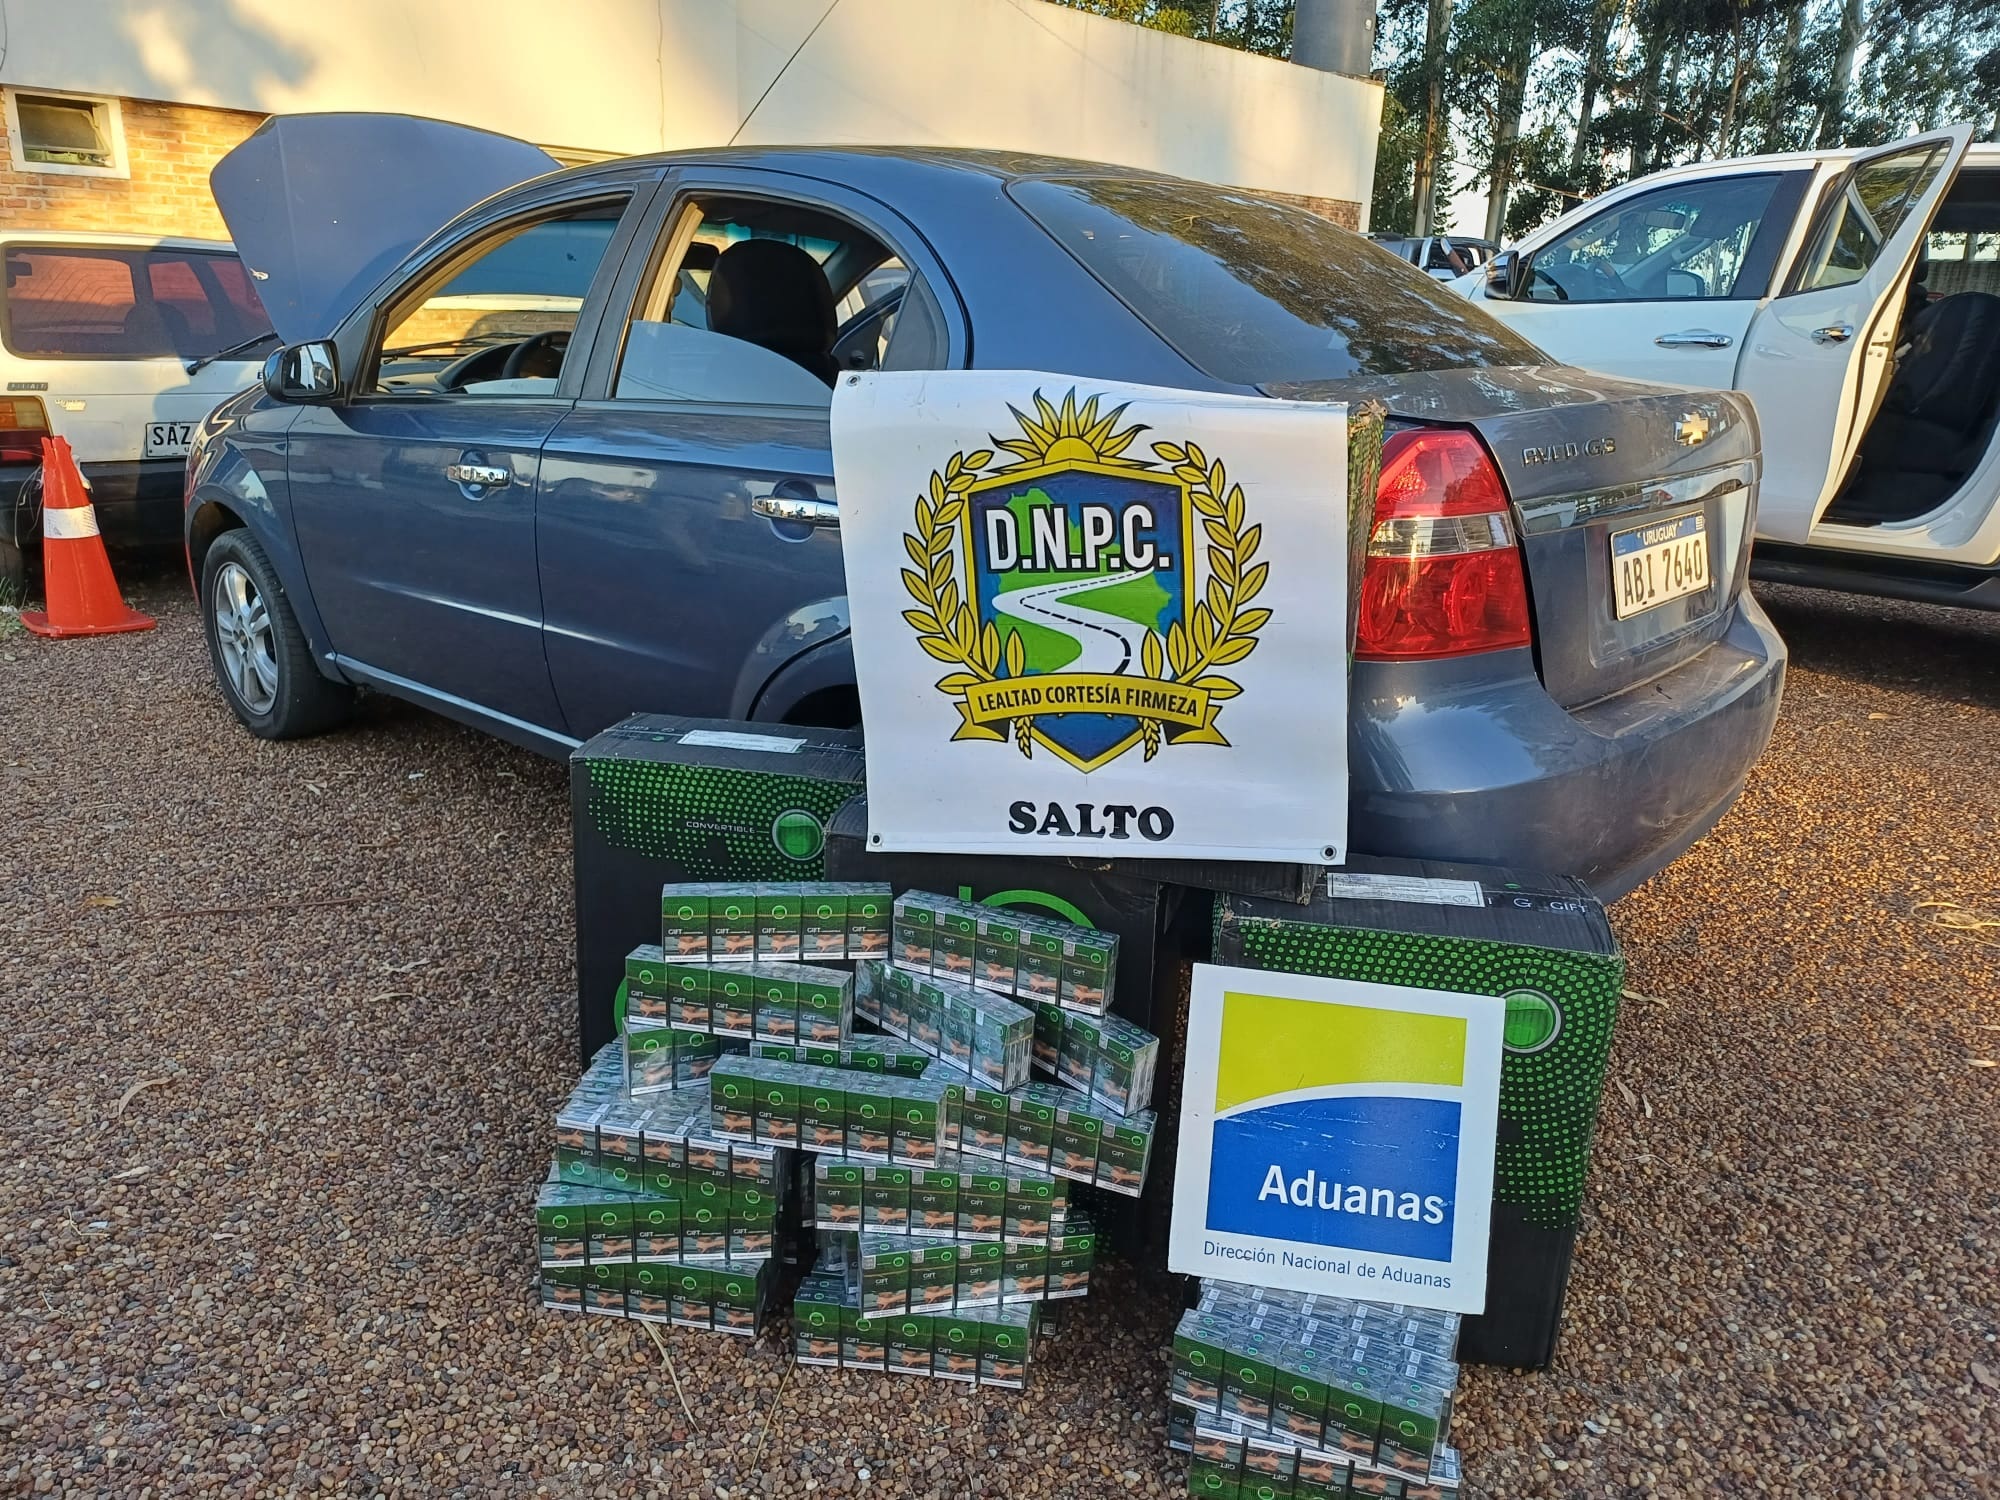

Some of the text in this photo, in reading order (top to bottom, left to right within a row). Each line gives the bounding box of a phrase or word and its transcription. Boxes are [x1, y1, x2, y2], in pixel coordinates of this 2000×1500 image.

[153, 426, 191, 446] SAZ
[986, 505, 1171, 571] D.N.P.C.
[1643, 523, 1678, 546] URUGUAY
[1623, 539, 1703, 607] ABI 7640
[978, 683, 1198, 718] LEALTAD CORTESÍA FIRMEZA
[686, 821, 755, 832] CONVERTIBLE
[1008, 801, 1175, 842] SALTO
[1550, 901, 1588, 913] GIFT
[1258, 1165, 1444, 1225] Aduanas
[1204, 1241, 1452, 1289] Dirección Nacional de Aduanas
[1177, 1368, 1192, 1378] GIFT
[1227, 1385, 1242, 1395] GIFT
[1278, 1403, 1294, 1413] GIFT
[1330, 1419, 1346, 1430] GIFT
[1384, 1437, 1401, 1447] GIFT
